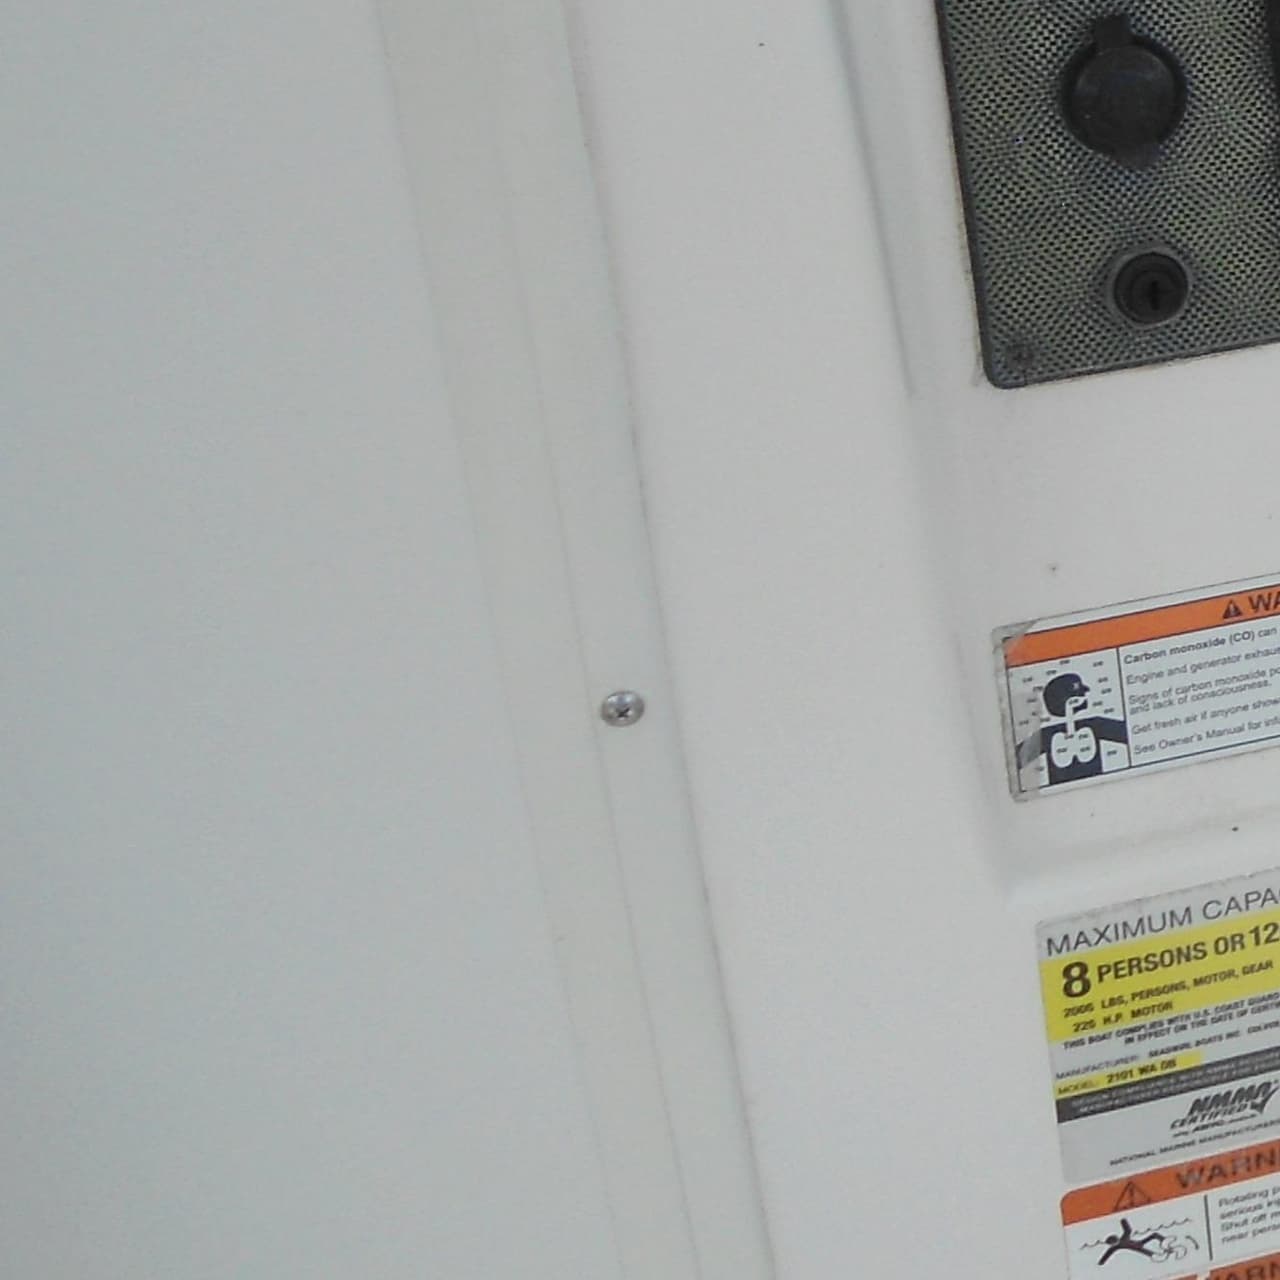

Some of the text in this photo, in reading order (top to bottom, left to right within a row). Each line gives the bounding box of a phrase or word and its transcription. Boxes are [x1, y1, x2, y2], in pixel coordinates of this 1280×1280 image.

[1124, 648, 1166, 664] Carbon
[1168, 636, 1226, 655] monoxide
[1229, 629, 1256, 646] (CO)
[1258, 626, 1278, 638] can
[1126, 670, 1165, 685] Engine
[1167, 664, 1188, 677] and
[1190, 654, 1242, 674] generator
[1128, 691, 1159, 704] Signs
[1161, 686, 1173, 698] of
[1175, 680, 1212, 695] carbon
[1214, 669, 1266, 687] monoxide
[1130, 702, 1150, 715] and
[1152, 697, 1175, 710] lack
[1177, 694, 1189, 705] of
[1190, 680, 1272, 703] consciousness.
[1132, 722, 1152, 736] Get
[1154, 716, 1181, 731] fresh
[1184, 714, 1198, 725] air
[1200, 711, 1208, 721] if
[1210, 703, 1249, 719] anyone
[1134, 743, 1156, 755] See
[1158, 732, 1203, 749] Owner's
[1205, 722, 1245, 739] Manual
[1247, 720, 1262, 730] for
[1047, 905, 1193, 957] MAXIMUM
[1062, 961, 1092, 998] 8
[1096, 942, 1208, 983] PERSONS
[1213, 932, 1246, 956] OR
[1101, 959, 1274, 1010] LBS, PERSONS, MOTOR, GEAR
[1063, 1038, 1086, 1050] THIS
[1087, 1031, 1113, 1045] BOAT
[1115, 1020, 1165, 1038] COMPLIES
[1166, 1013, 1191, 1026] WITH
[1214, 999, 1246, 1014] COAST
[1247, 992, 1280, 1006] GUARD
[1130, 1000, 1173, 1019] MOTOR
[1137, 1027, 1171, 1042] EFFECT
[1190, 1018, 1208, 1029] THE
[1211, 1013, 1234, 1024] DATE
[1169, 1102, 1249, 1130] CERTIFIED
[1109, 1149, 1156, 1167] NATIONAL
[1159, 1139, 1196, 1153] MARINE
[1218, 1188, 1269, 1208] Rotating
[1219, 1203, 1263, 1220] serious
[1220, 1218, 1249, 1233] Shut
[1251, 1212, 1267, 1225] off
[1221, 1230, 1249, 1244] near
